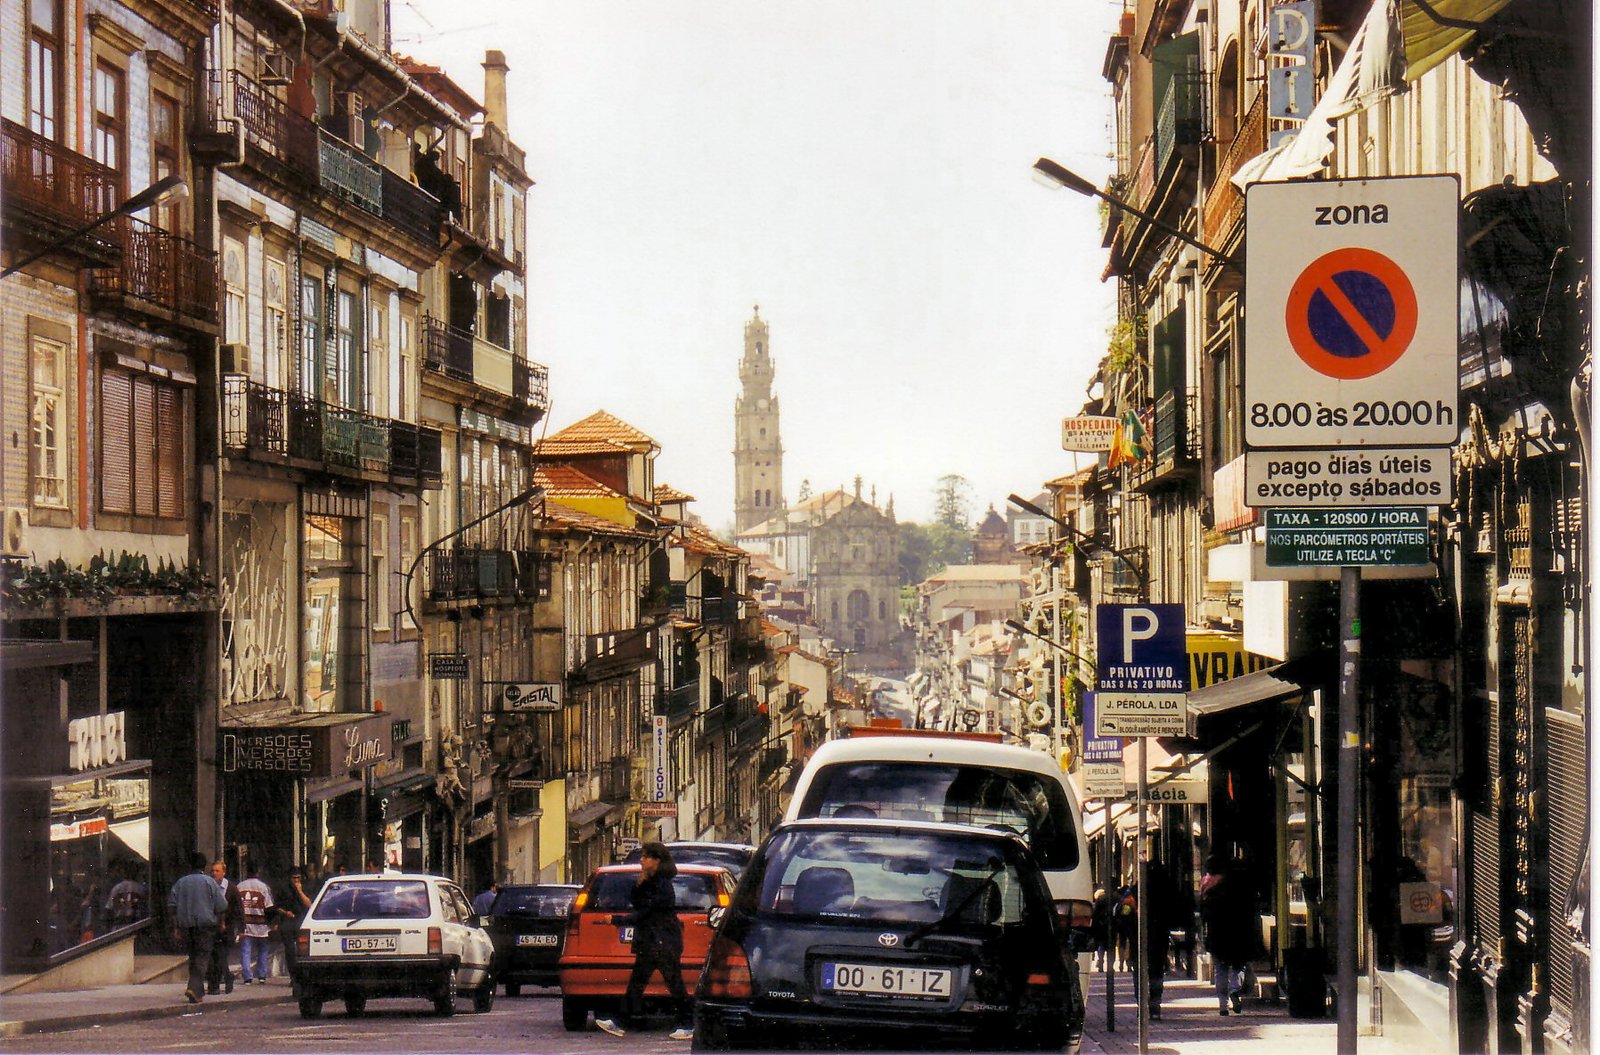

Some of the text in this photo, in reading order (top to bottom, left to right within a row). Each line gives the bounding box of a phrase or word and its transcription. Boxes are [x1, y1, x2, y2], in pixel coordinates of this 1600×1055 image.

[1274, 9, 1309, 149] DI
[1315, 203, 1389, 226] zona
[1251, 400, 1453, 428] 8.00 às 20.00 h
[1267, 455, 1432, 479] pago dias úteis
[1257, 478, 1441, 500] excepto sábados
[1274, 513, 1310, 525] TAXA
[1379, 512, 1419, 524] HORA
[1270, 531, 1425, 546] NOS PARCÓMETROS PORTÁTEIS
[1297, 550, 1333, 561] UTILIZE
[1336, 550, 1343, 561] A
[1345, 550, 1377, 561] TECLA
[1123, 608, 1159, 664] P
[1109, 666, 1173, 678] PRIVATIVO
[1101, 680, 1116, 689] DAS
[1119, 680, 1124, 689] 8
[1142, 680, 1153, 689] 20
[1156, 680, 1183, 689] HORAS
[512, 686, 558, 707] CRISTAL
[1106, 700, 1114, 709] J.
[1160, 700, 1178, 709] LDA
[344, 726, 385, 767] Luna
[768, 991, 795, 999] TOYOTA
